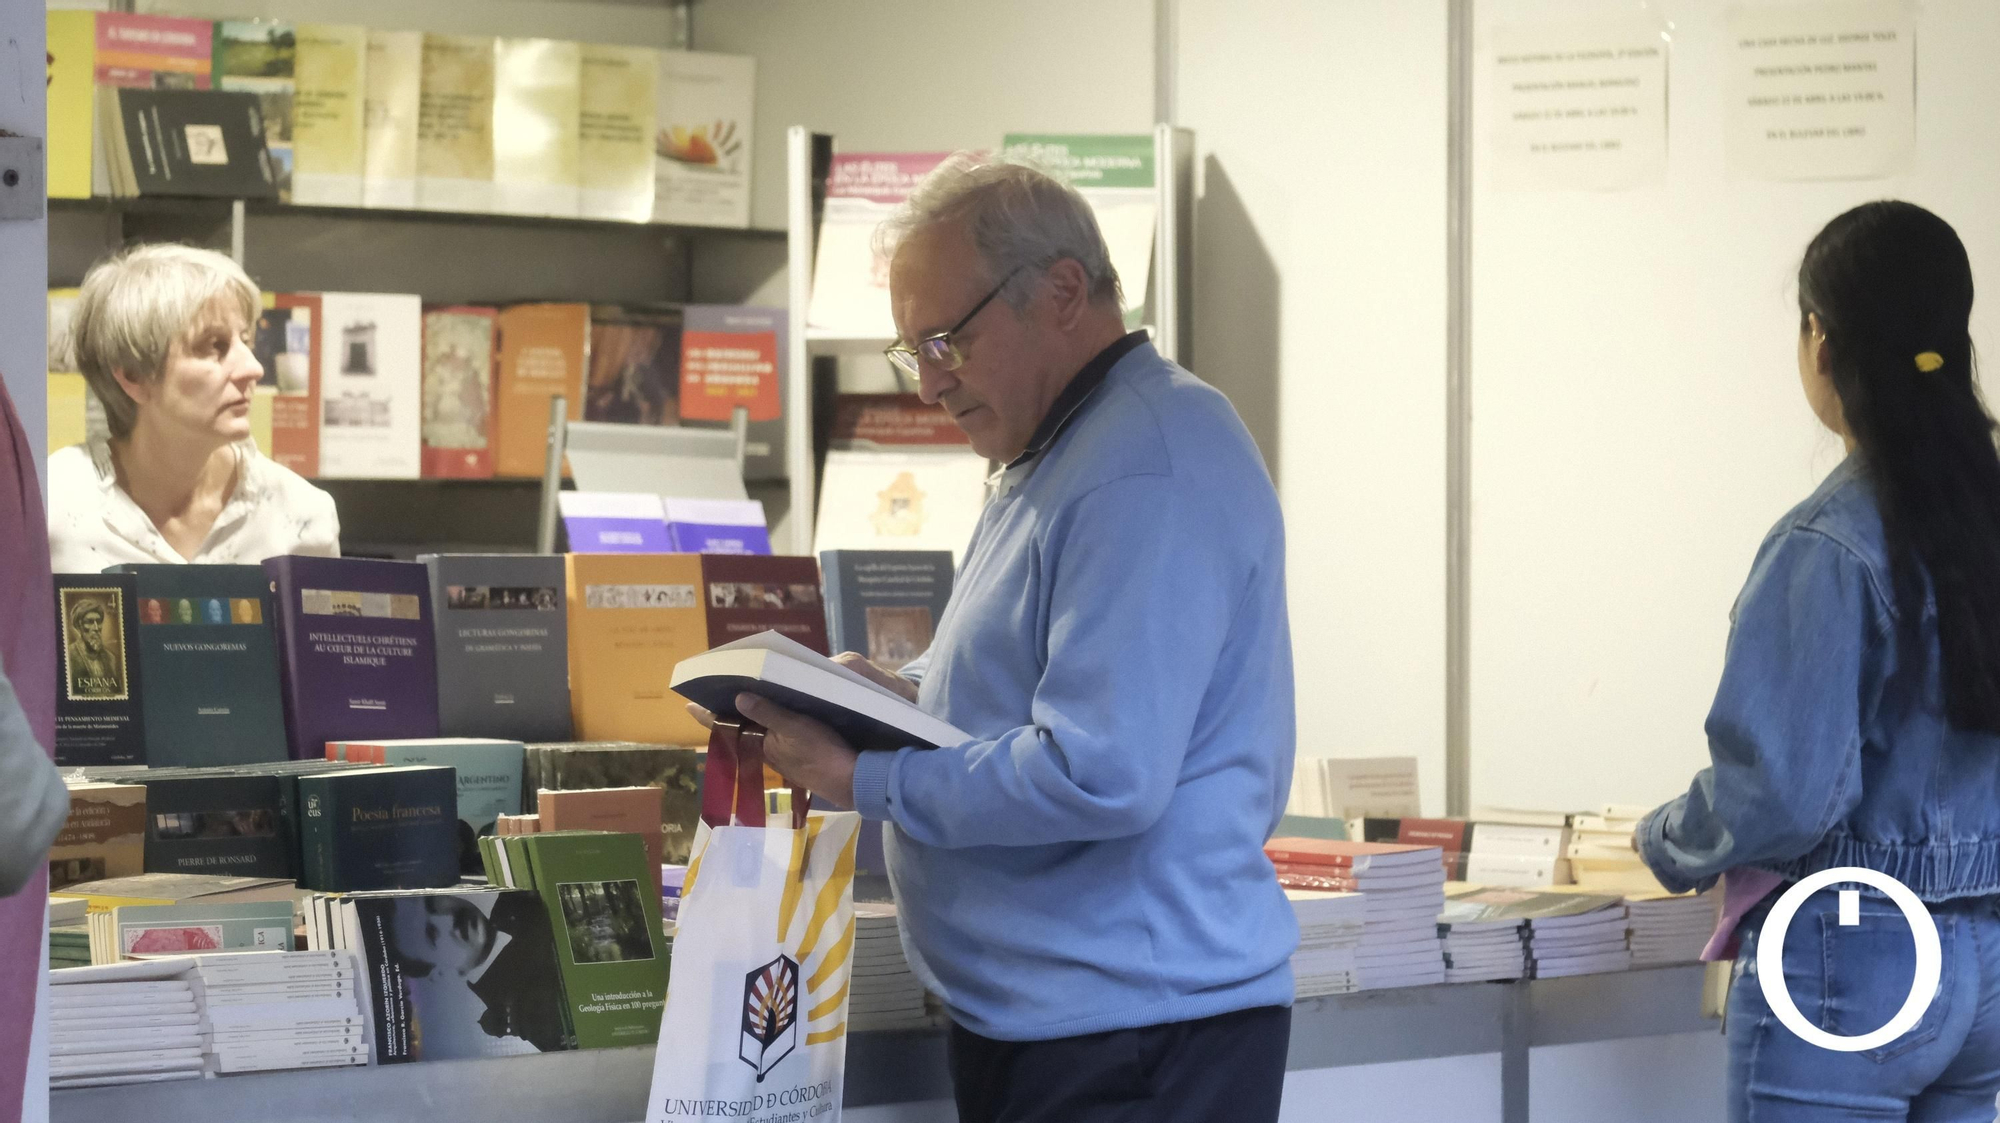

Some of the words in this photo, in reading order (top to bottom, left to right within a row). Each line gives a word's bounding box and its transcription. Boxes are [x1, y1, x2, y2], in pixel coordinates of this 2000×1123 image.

[107, 593, 116, 608] 4
[309, 632, 371, 644] INTELLECTUELS
[372, 635, 417, 646] CHRÉTIENS
[163, 643, 194, 651] NUEVOS
[314, 644, 326, 652] AU
[353, 645, 365, 654] DE
[366, 646, 377, 655] LA
[377, 647, 414, 657] CULTURE
[343, 655, 387, 667] ISLAMIQUE
[352, 806, 389, 822] Poesía
[392, 802, 442, 818] francesa
[178, 858, 204, 866] PIERRE
[206, 857, 218, 865] DE
[219, 854, 257, 865] RONSARD
[380, 964, 388, 997] IZQUIERDO
[591, 992, 604, 1002] Una
[604, 990, 642, 1001] introducción
[646, 989, 653, 998] la
[578, 1004, 605, 1014] Geología
[605, 1002, 622, 1011] Física
[631, 1001, 642, 1009] 100
